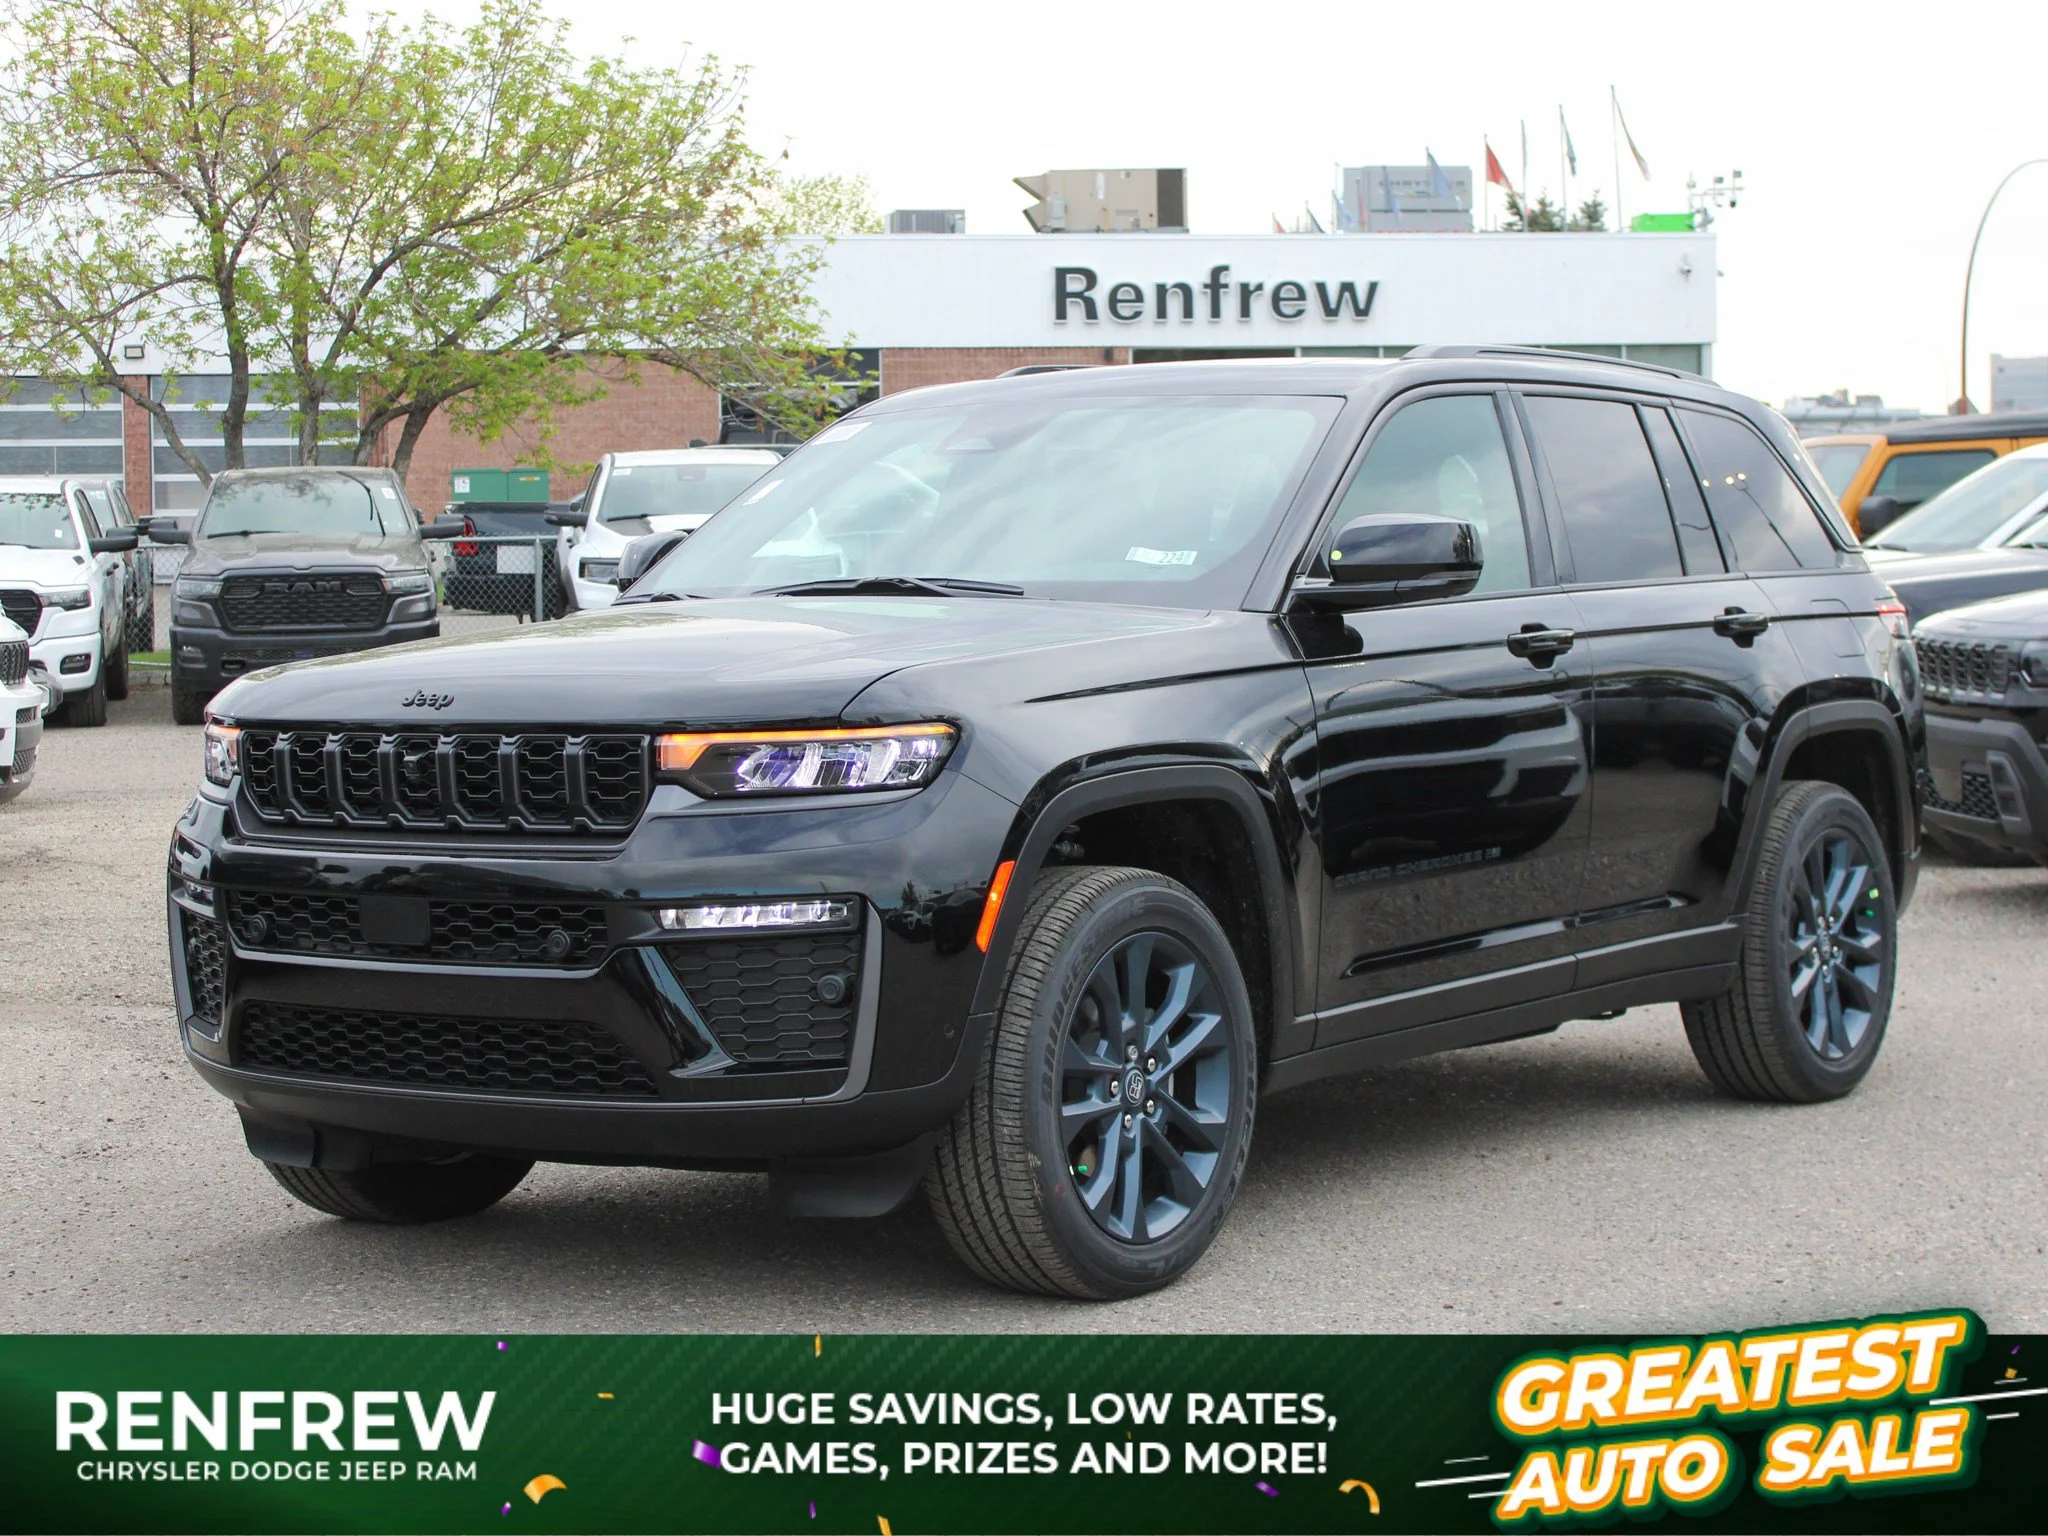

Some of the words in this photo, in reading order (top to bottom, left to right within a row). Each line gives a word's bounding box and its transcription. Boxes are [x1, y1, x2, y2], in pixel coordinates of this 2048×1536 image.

[1054, 264, 1379, 323] Renfrew
[264, 581, 341, 593] RAM
[401, 689, 455, 711] Jeep
